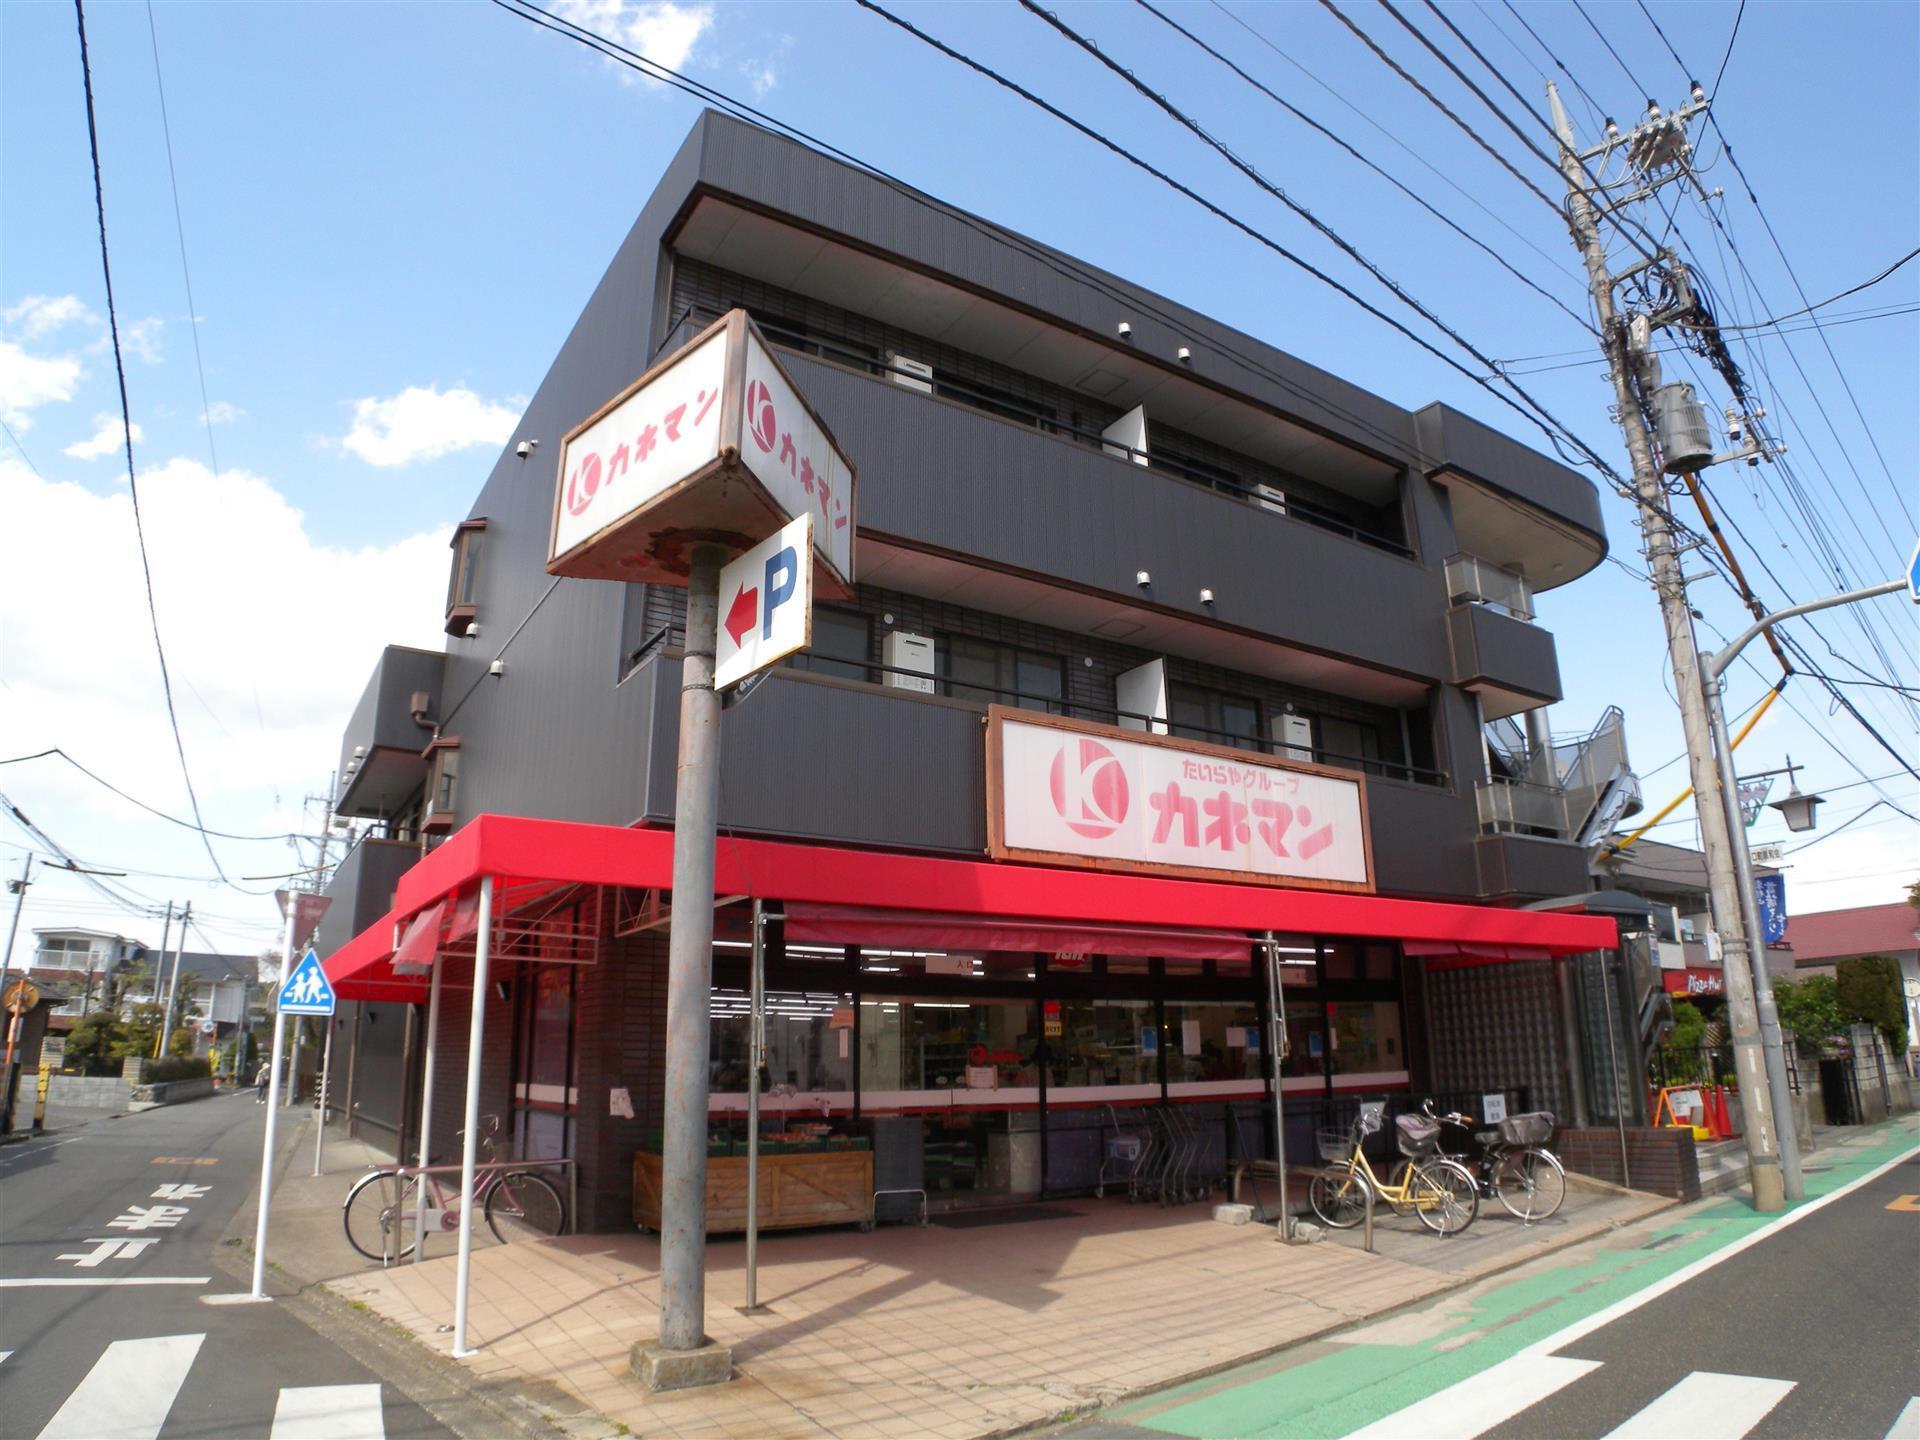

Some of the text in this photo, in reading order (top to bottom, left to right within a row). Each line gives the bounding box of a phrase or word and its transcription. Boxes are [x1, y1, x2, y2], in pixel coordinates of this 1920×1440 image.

[604, 386, 719, 486] カネマン
[779, 431, 848, 530] カネマン
[762, 544, 798, 641] P
[1148, 781, 1335, 861] カネマン
[1181, 758, 1300, 795] たいらやグループ
[54, 1183, 214, 1267] 止まれ
